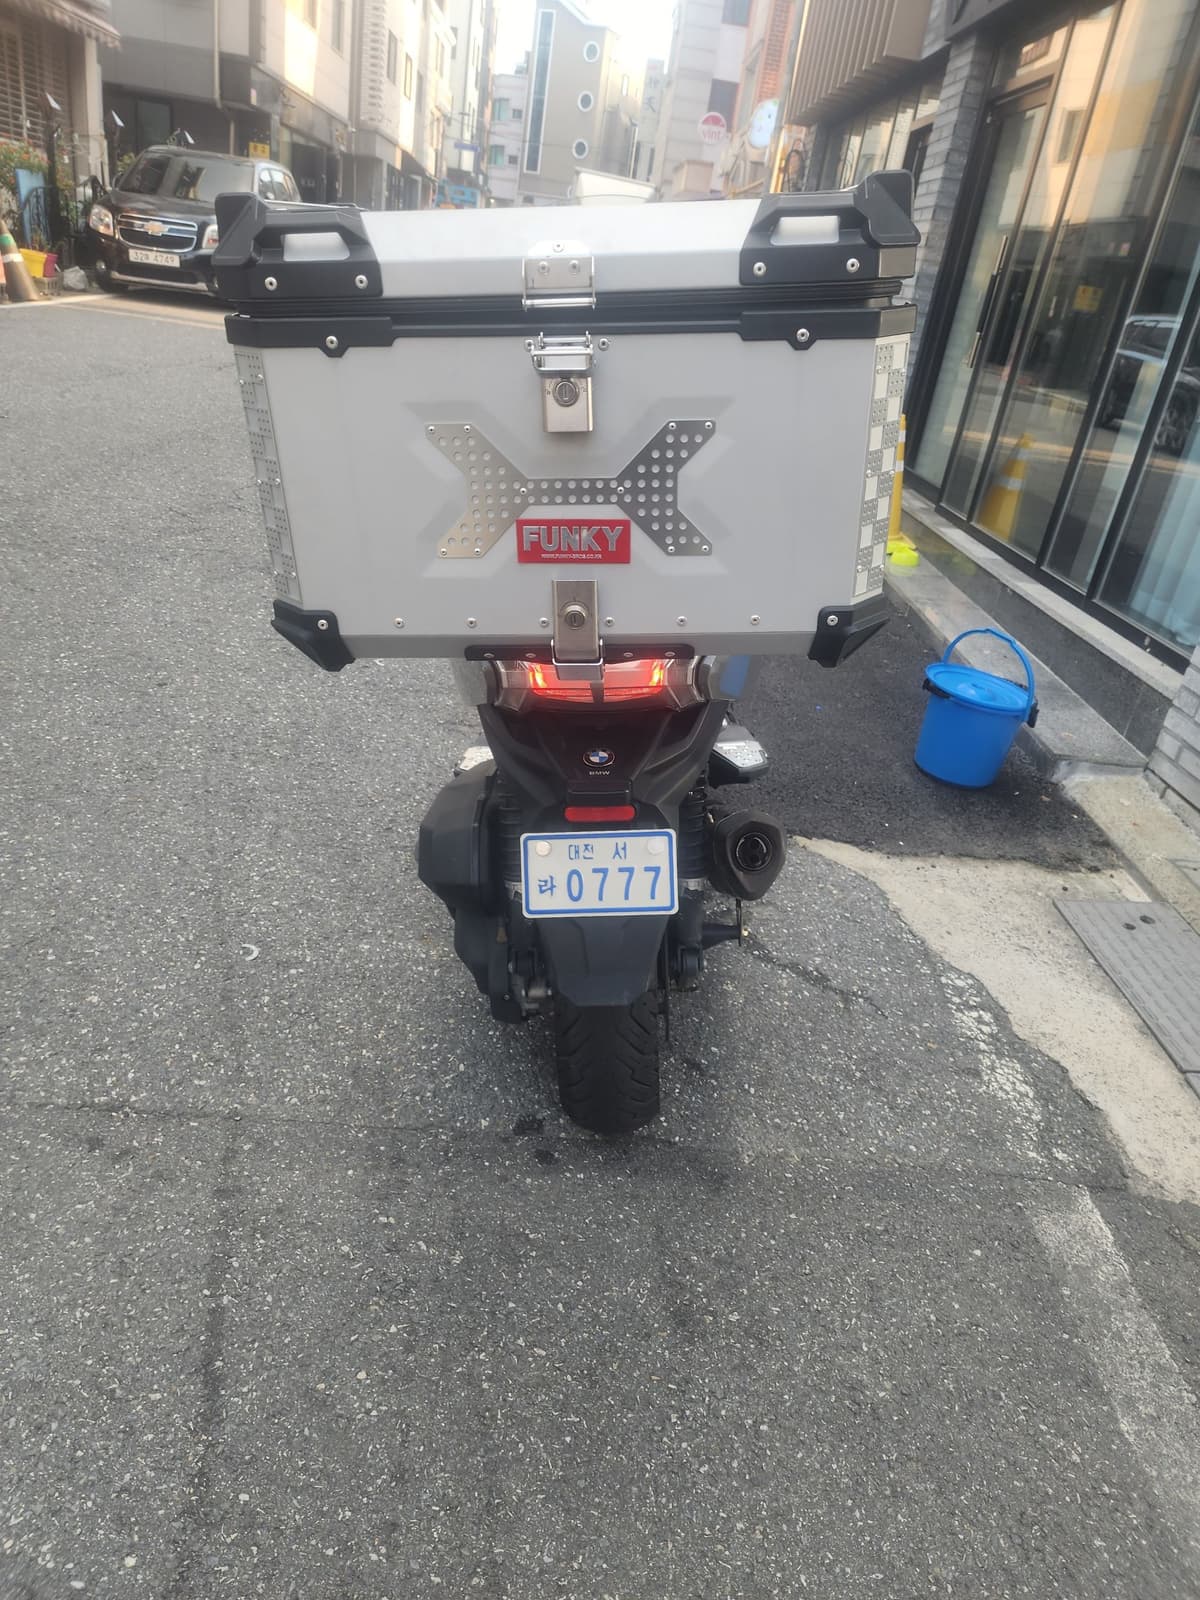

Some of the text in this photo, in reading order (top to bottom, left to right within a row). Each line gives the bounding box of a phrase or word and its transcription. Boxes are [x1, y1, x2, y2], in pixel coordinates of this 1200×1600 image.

[522, 525, 624, 552] FUNKY
[568, 841, 628, 861] 대전 서
[537, 866, 661, 903] 라 0777
